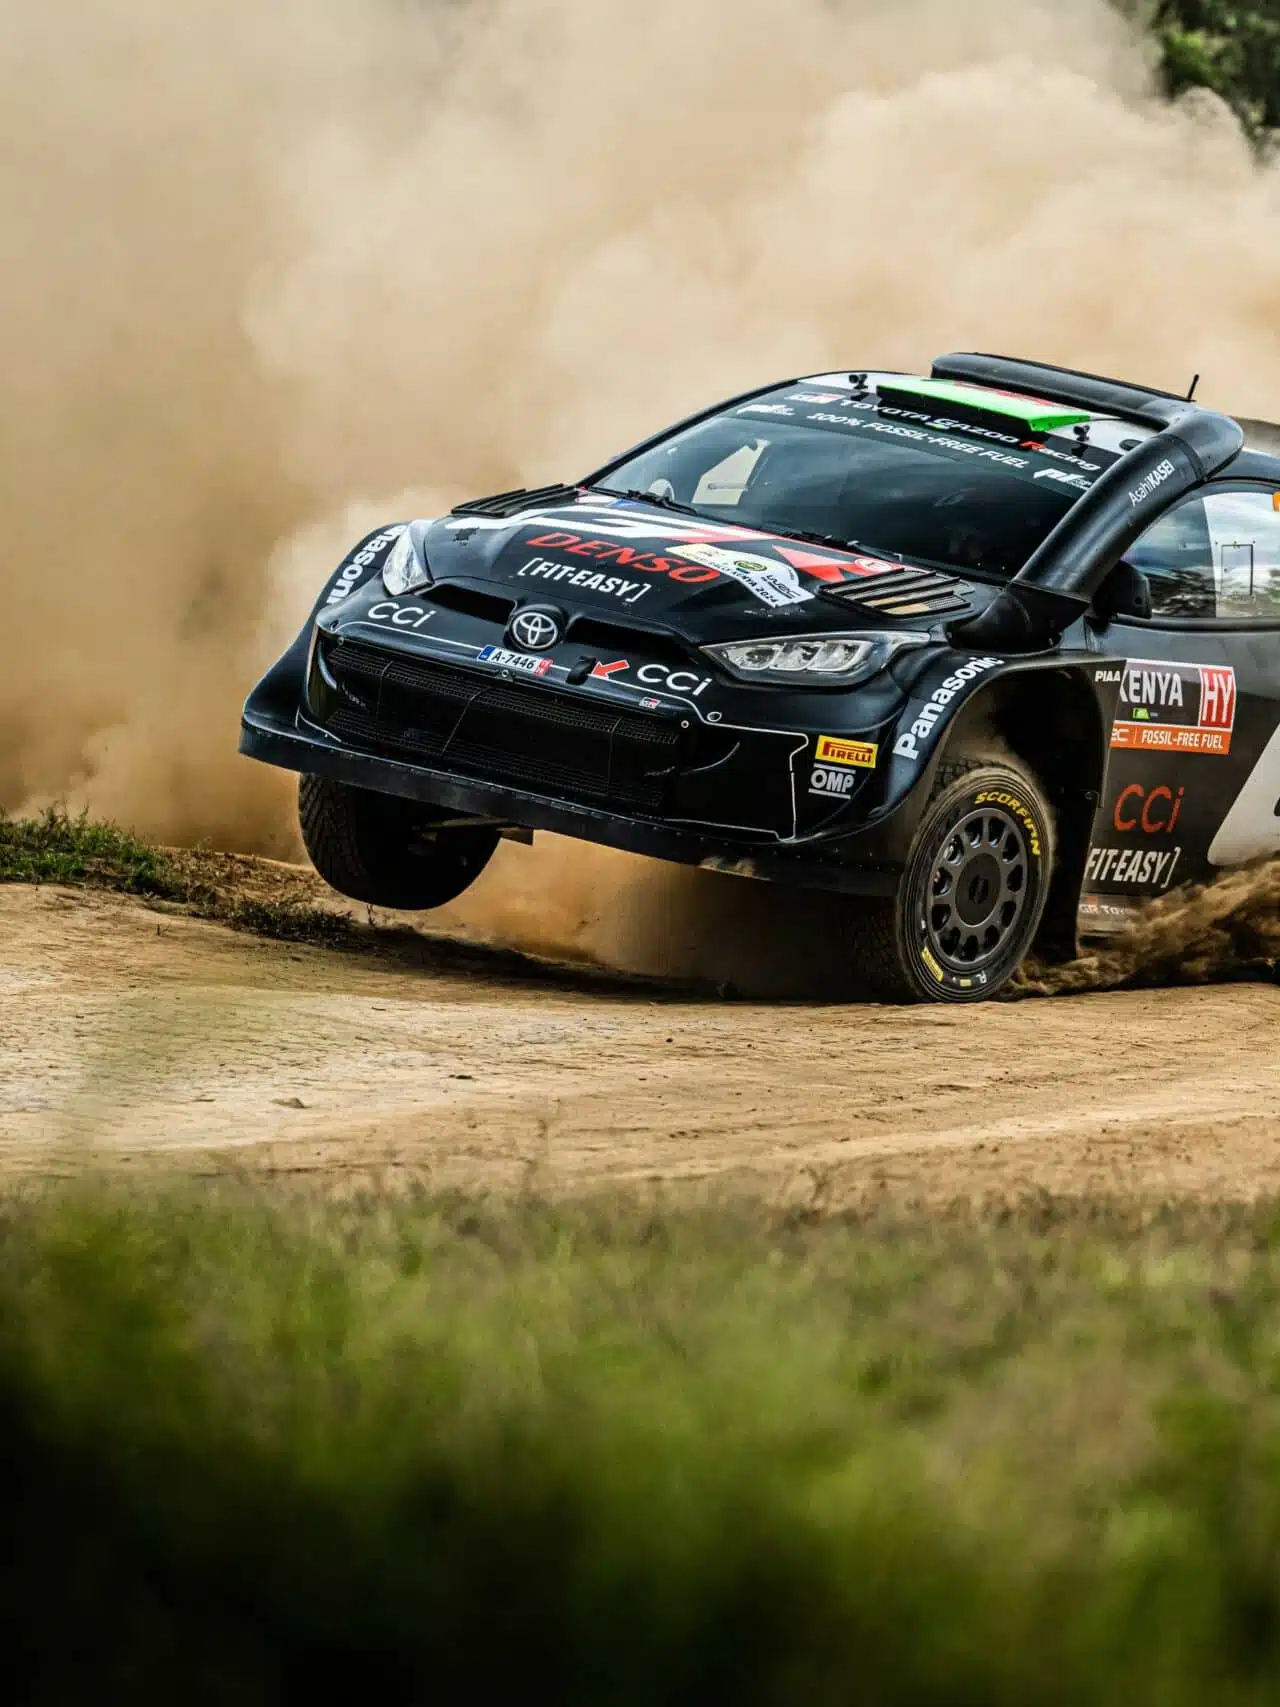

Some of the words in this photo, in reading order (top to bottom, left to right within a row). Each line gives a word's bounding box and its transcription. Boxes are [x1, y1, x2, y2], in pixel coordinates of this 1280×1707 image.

[840, 400, 931, 421] TOYOTA
[806, 412, 865, 427] 100%
[978, 450, 1030, 468] FUEL
[525, 532, 721, 583] DENSO
[756, 585, 778, 603] 2024
[491, 651, 536, 671] A-7446
[893, 656, 1004, 760] Panasonic
[1202, 673, 1234, 724] HY
[1142, 730, 1200, 747] FOSSIL-FREE
[1201, 734, 1224, 750] FUEL
[822, 741, 874, 763] PIRELLI
[810, 769, 855, 793] OMP
